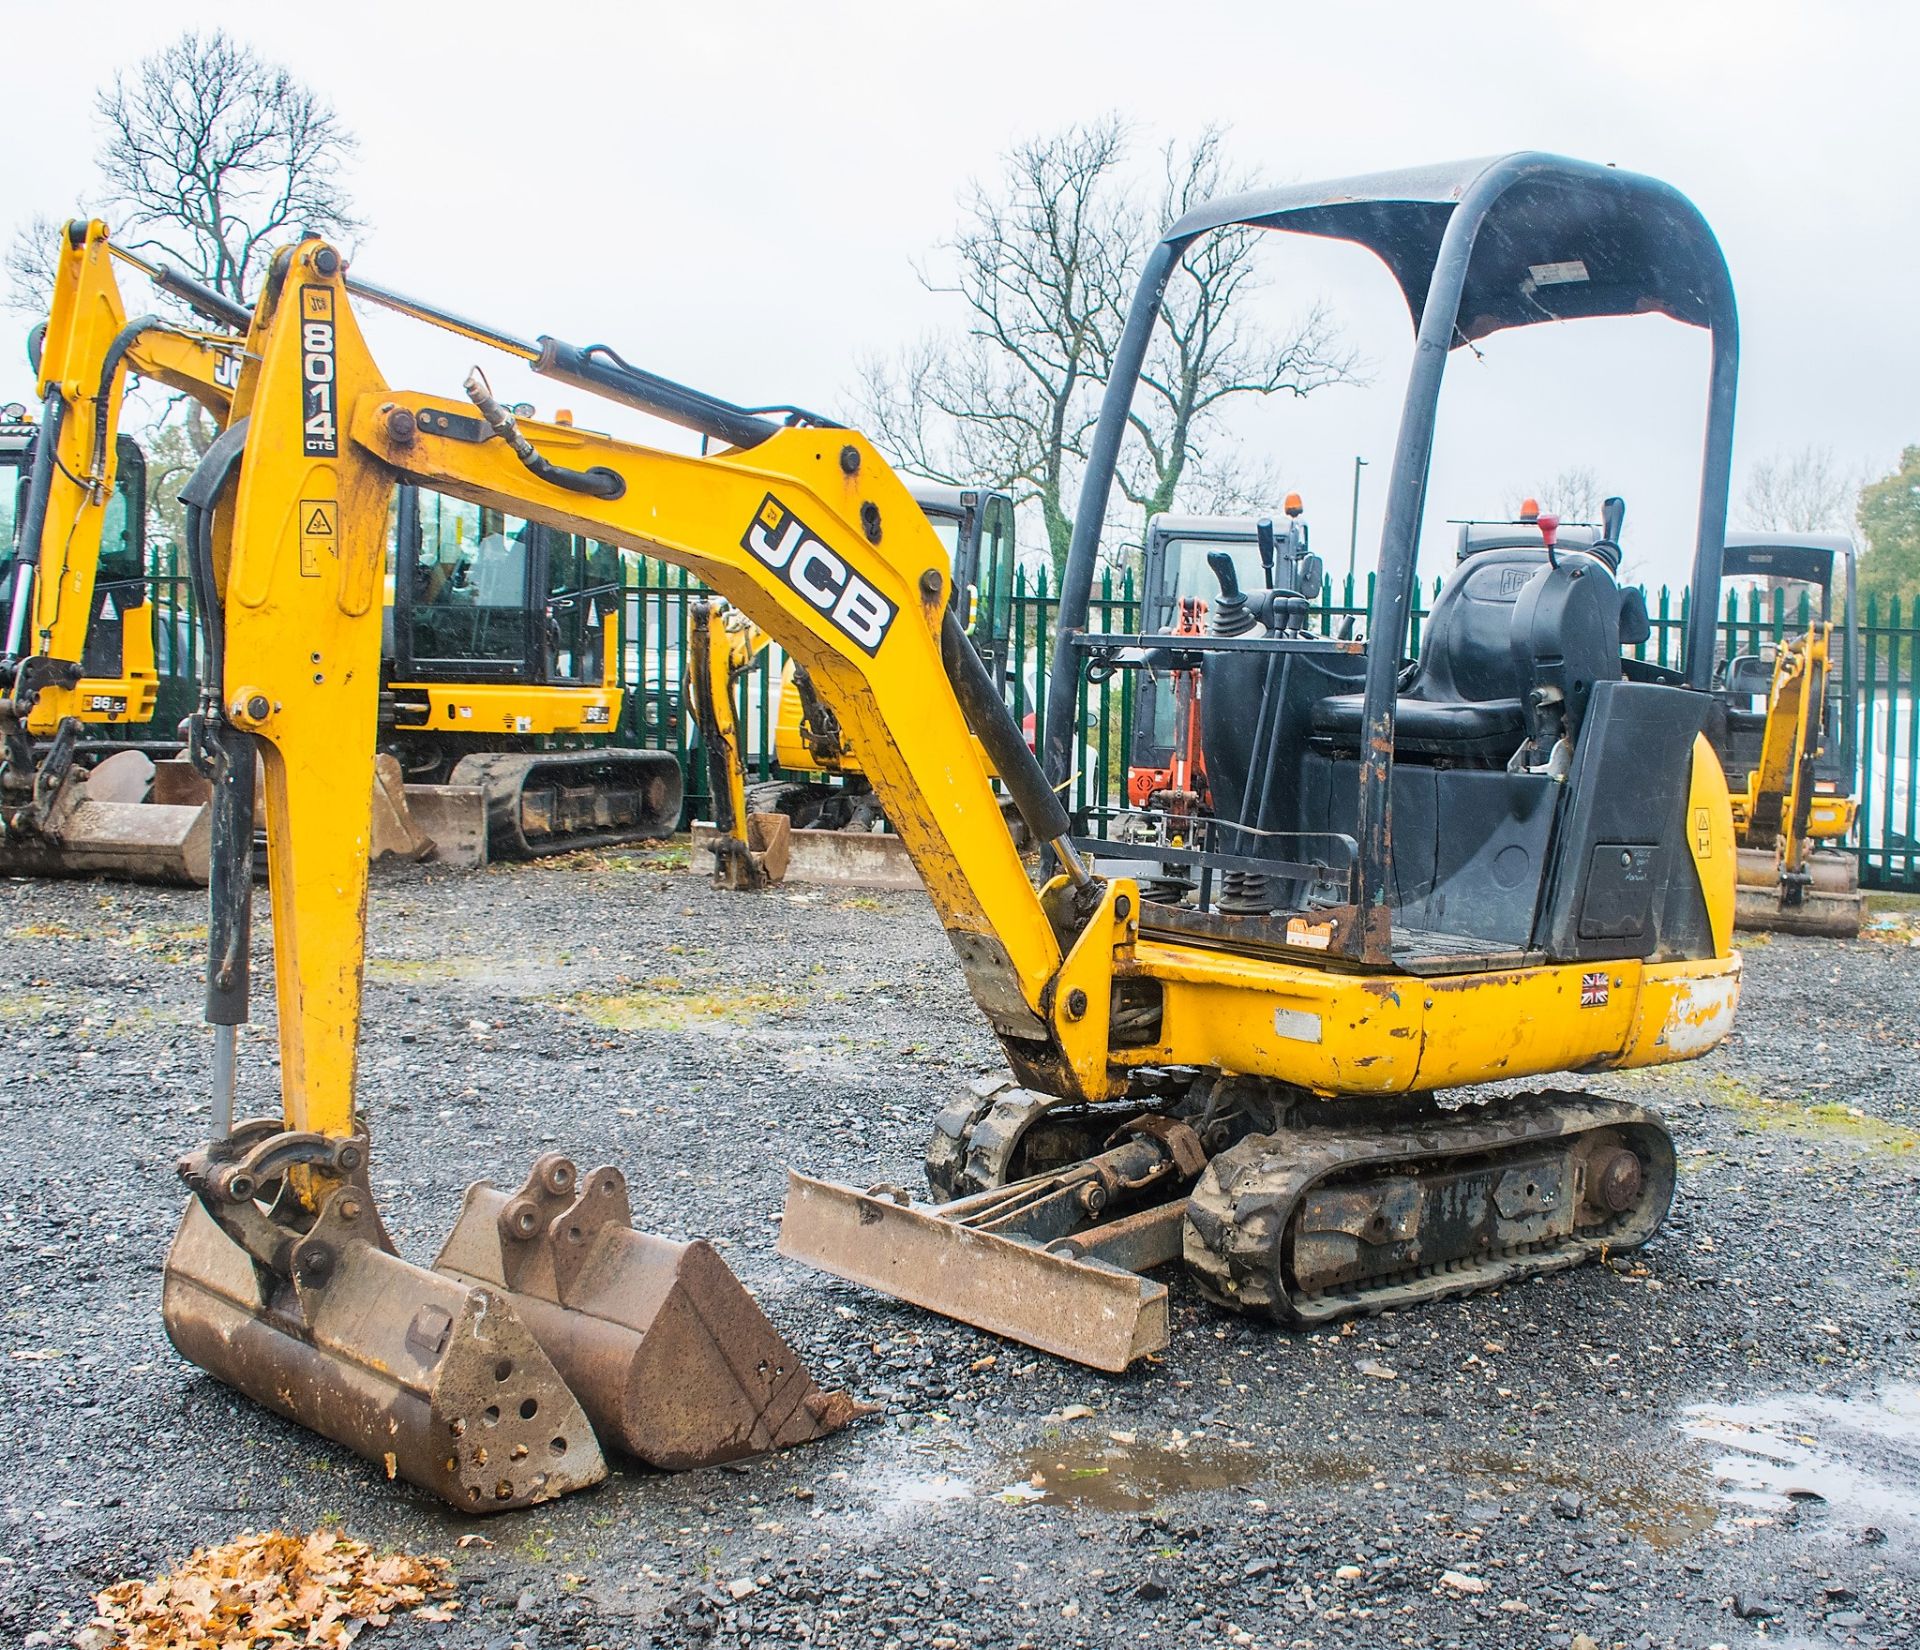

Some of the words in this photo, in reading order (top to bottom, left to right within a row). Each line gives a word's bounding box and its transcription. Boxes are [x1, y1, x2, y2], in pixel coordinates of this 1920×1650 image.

[215, 355, 241, 389] JC
[304, 323, 335, 440] 8014
[306, 440, 336, 451] CTS
[750, 520, 891, 648] JCB
[92, 696, 111, 709] 86
